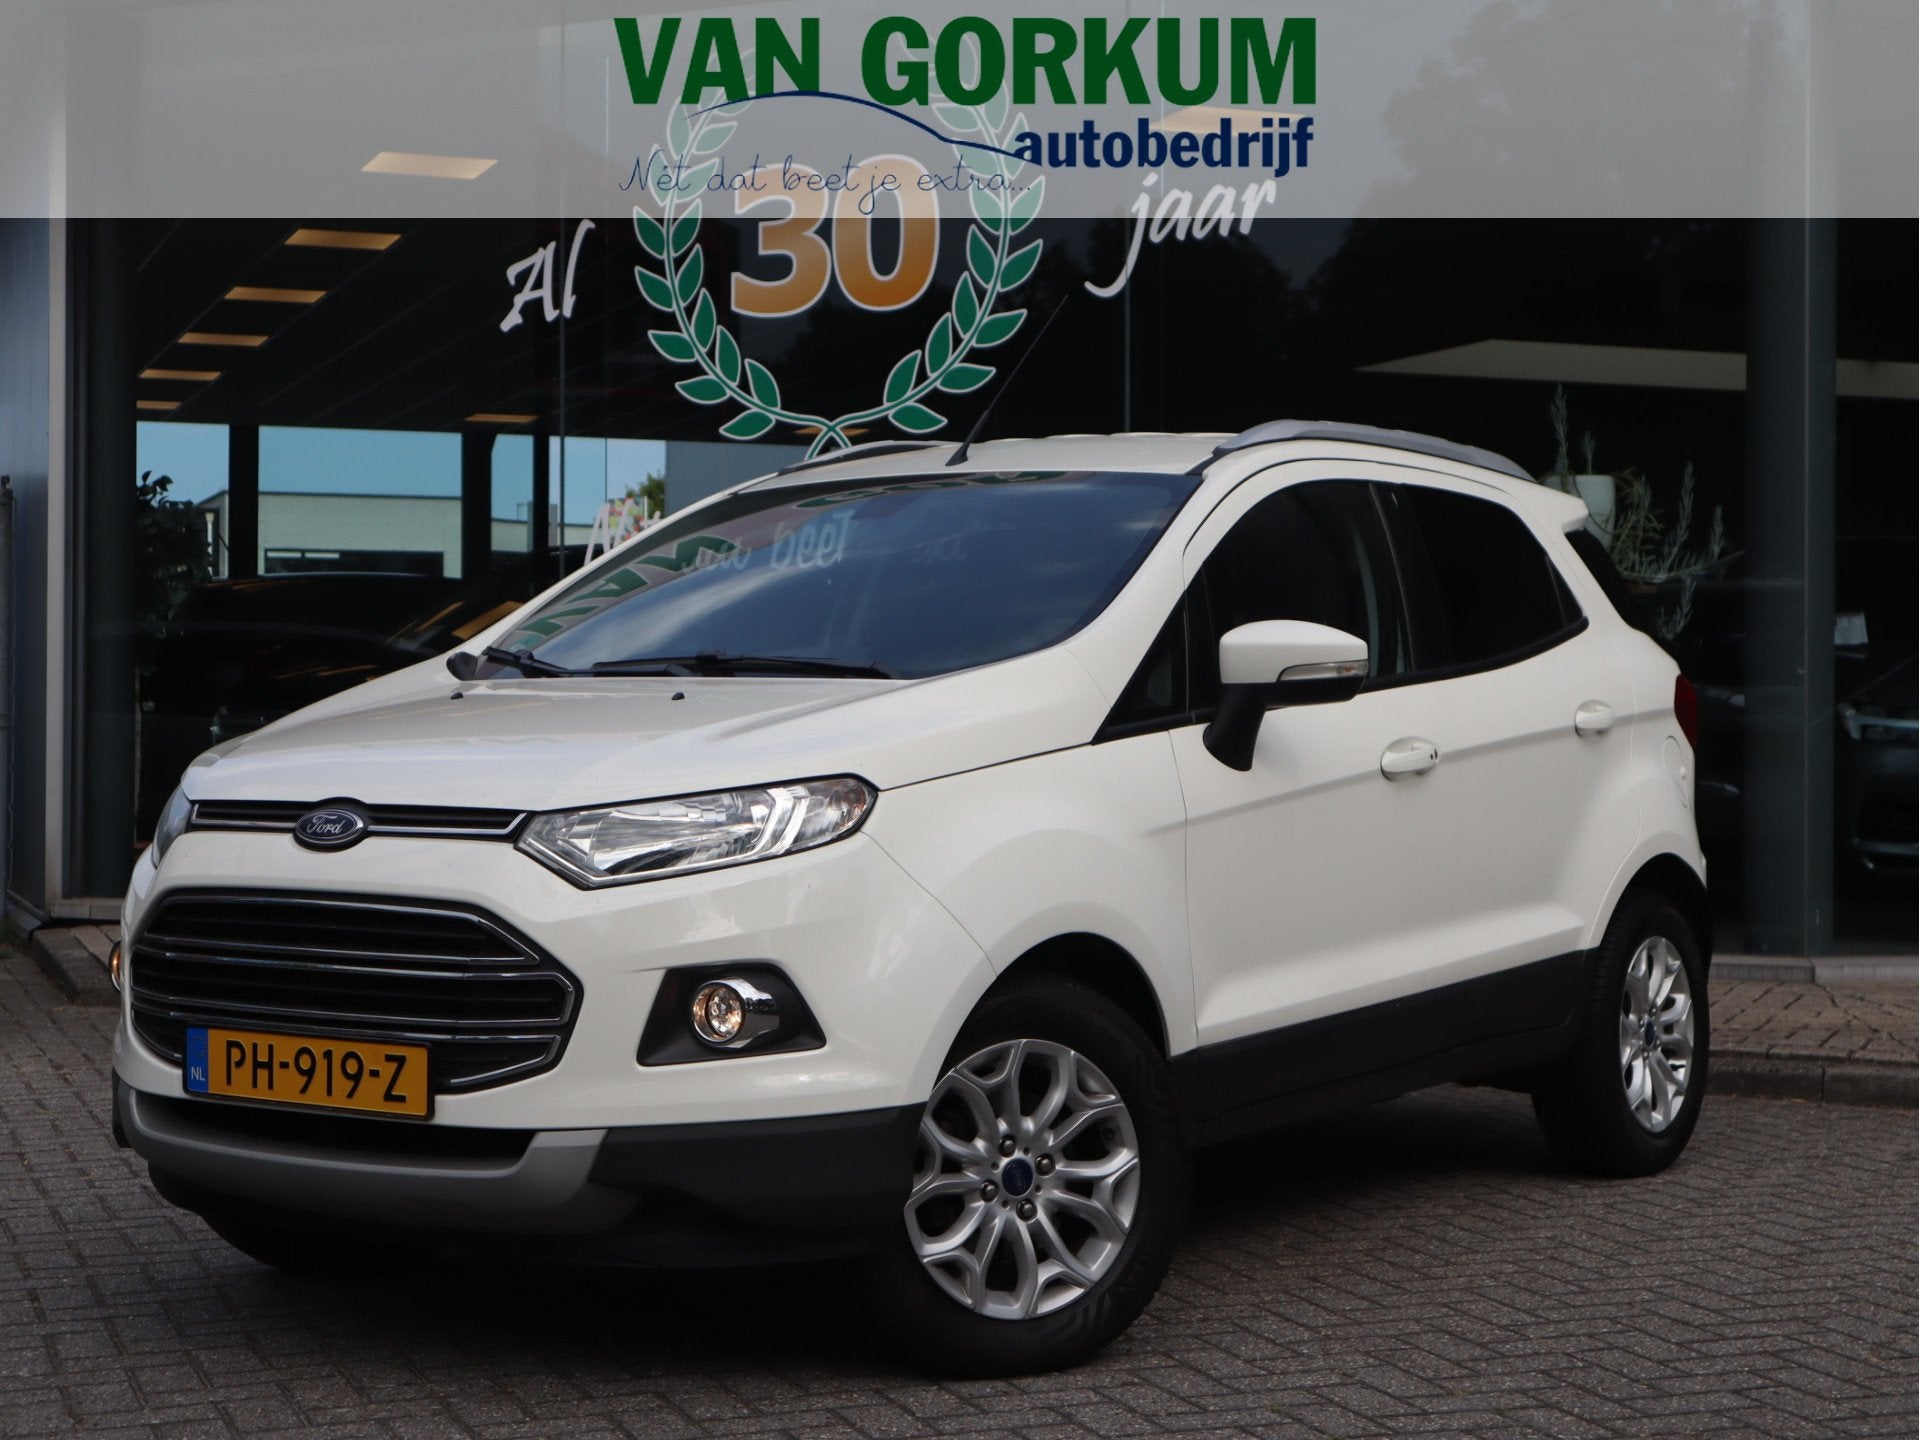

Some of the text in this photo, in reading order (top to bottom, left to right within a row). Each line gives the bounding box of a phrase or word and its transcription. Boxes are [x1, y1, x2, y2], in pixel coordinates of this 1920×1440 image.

[500, 154, 1278, 333] Al 30 jaar
[306, 814, 346, 834] Ford
[191, 1065, 206, 1082] NL
[225, 1039, 408, 1104] PH-919-Z
